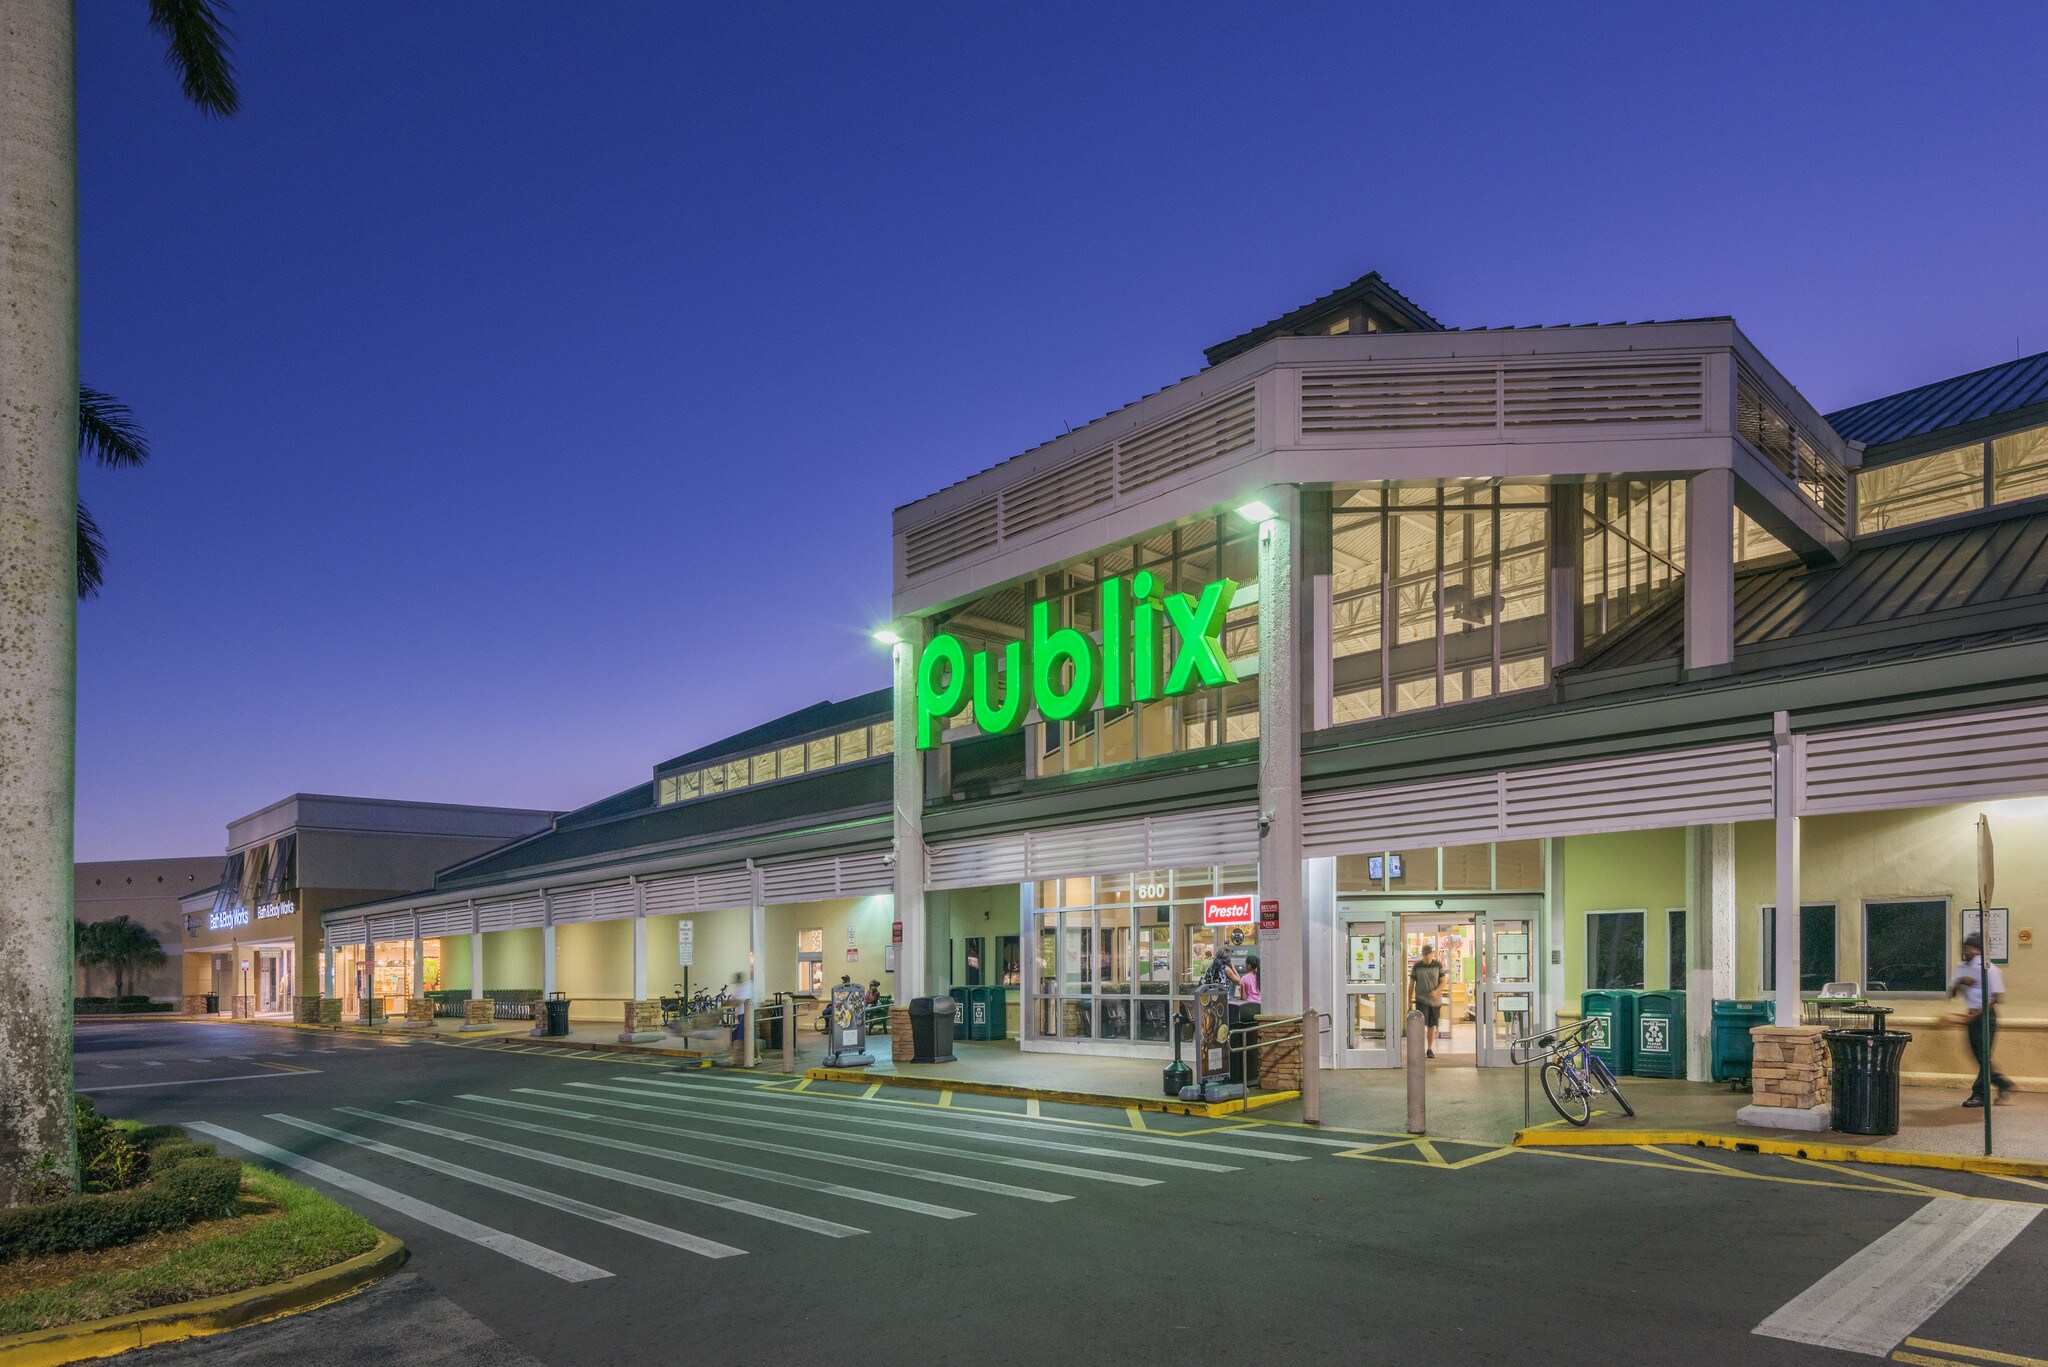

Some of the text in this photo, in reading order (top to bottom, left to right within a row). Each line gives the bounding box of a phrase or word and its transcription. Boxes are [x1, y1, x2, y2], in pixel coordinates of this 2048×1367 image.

[917, 570, 1239, 750] publix
[1139, 883, 1165, 899] 600
[210, 914, 219, 929] Bath
[223, 910, 234, 929] Body
[233, 907, 249, 925] Works
[258, 905, 266, 919] Bath
[270, 903, 280, 918] Body
[280, 900, 294, 915] Works
[1208, 902, 1249, 918] Presto!
